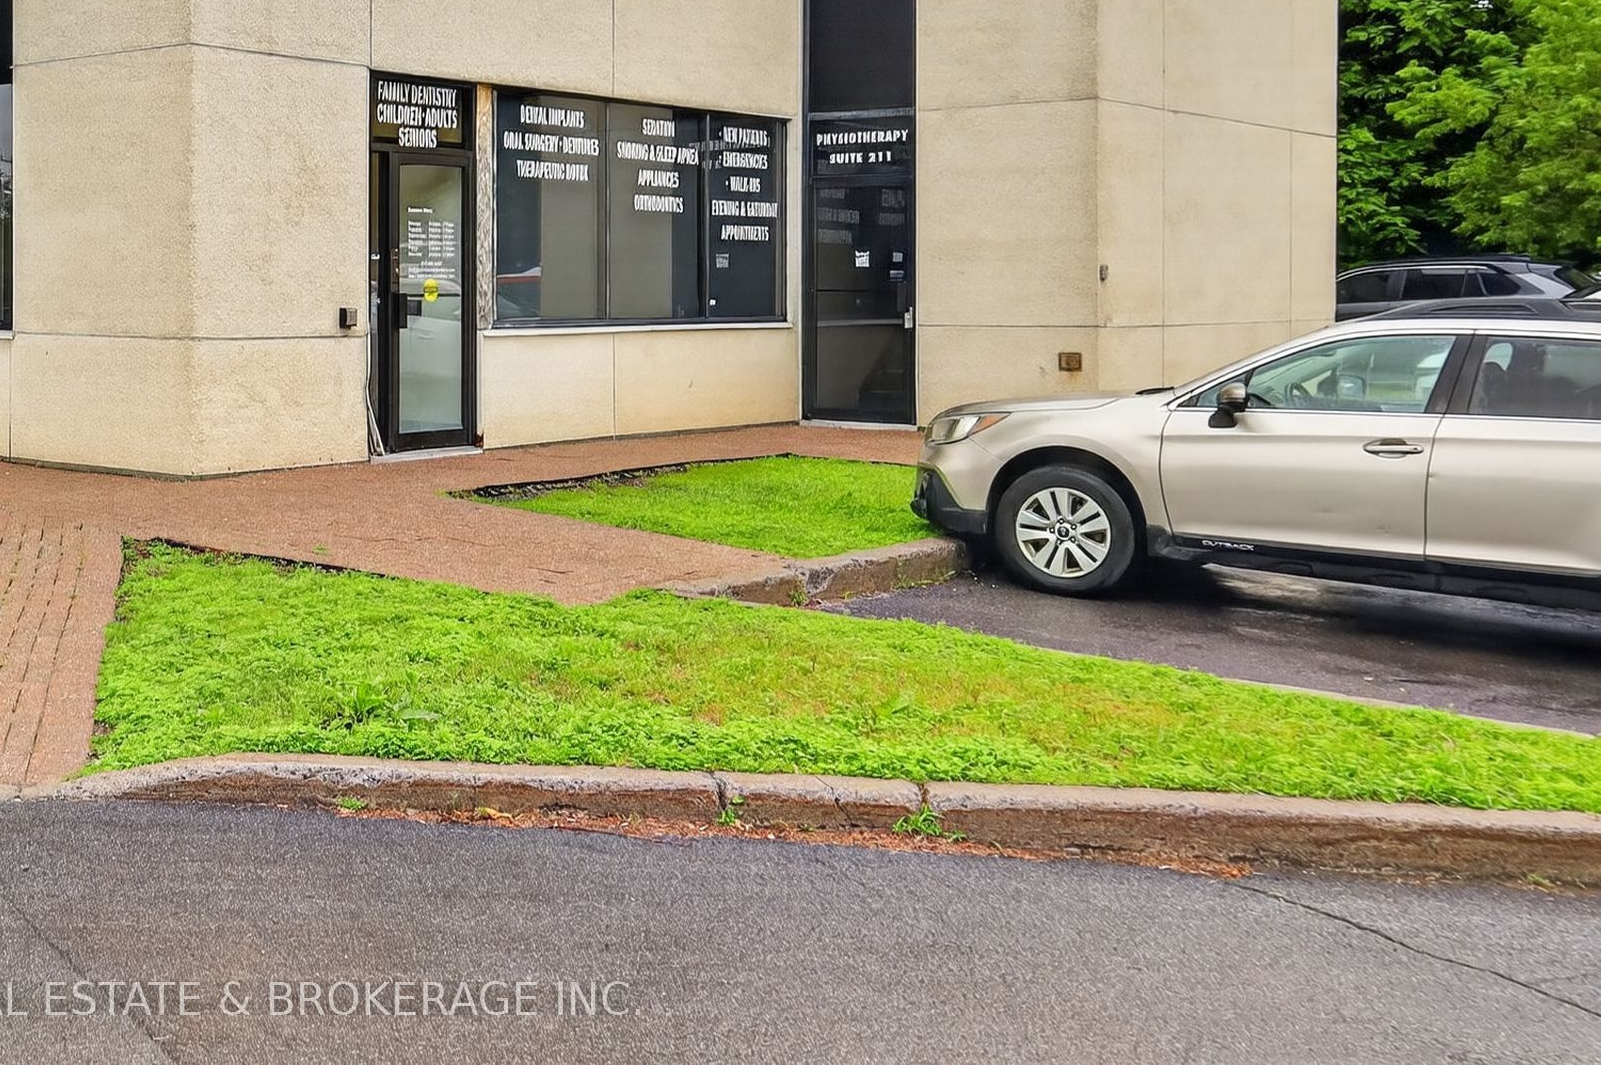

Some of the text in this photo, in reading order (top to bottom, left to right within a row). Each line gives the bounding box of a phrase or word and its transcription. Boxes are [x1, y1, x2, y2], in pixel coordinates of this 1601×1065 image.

[378, 81, 456, 108] FAMILY DENTISTRY
[377, 103, 457, 128] CHILDREN ADULTS
[520, 104, 547, 125] DENTAL
[398, 127, 437, 148] SENIORS
[816, 129, 909, 146] PHYSIOTHERAPY
[830, 151, 892, 164] SUITE 211
[1202, 540, 1254, 551] OUTBACK
